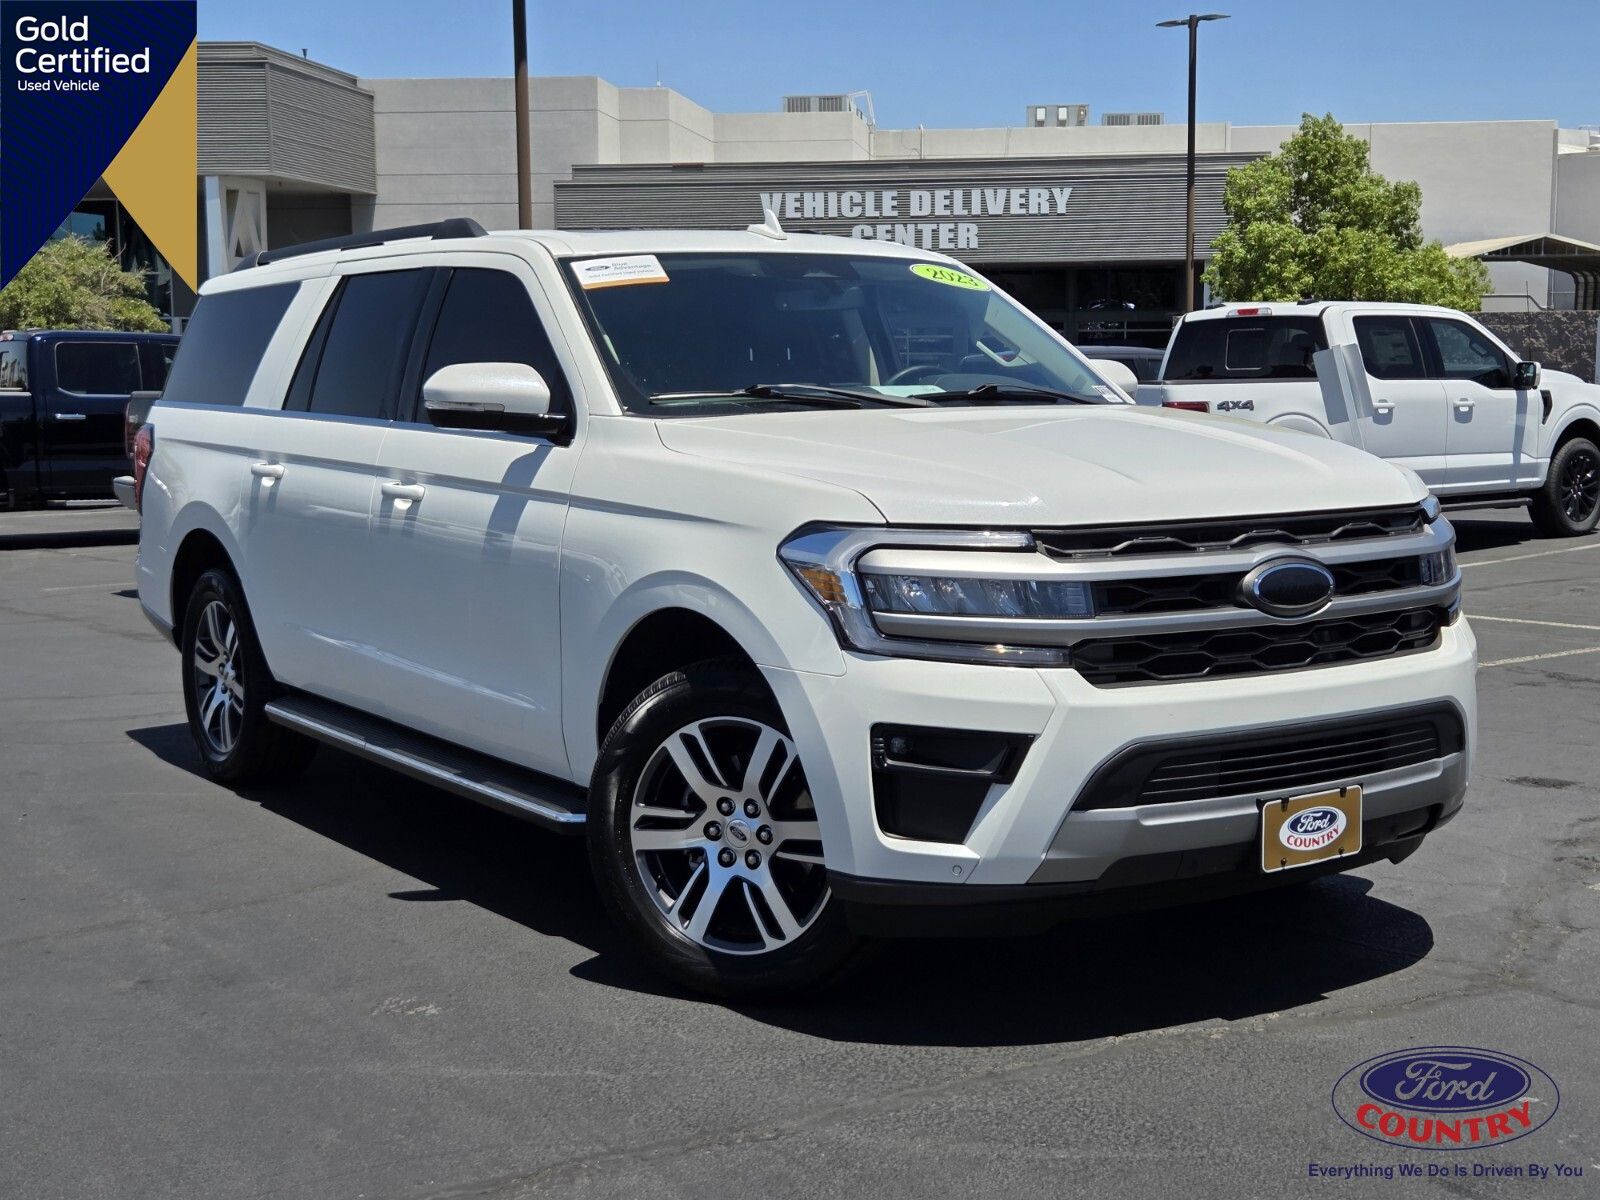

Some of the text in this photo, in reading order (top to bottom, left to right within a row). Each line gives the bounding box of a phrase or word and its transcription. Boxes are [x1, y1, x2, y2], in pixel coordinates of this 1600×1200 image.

[759, 187, 1073, 219] VEHICLE DELIVERY
[851, 223, 979, 250] CENTER
[926, 268, 979, 287] 2023
[1298, 812, 1330, 832] Ford
[1286, 826, 1340, 848] COUNTRY
